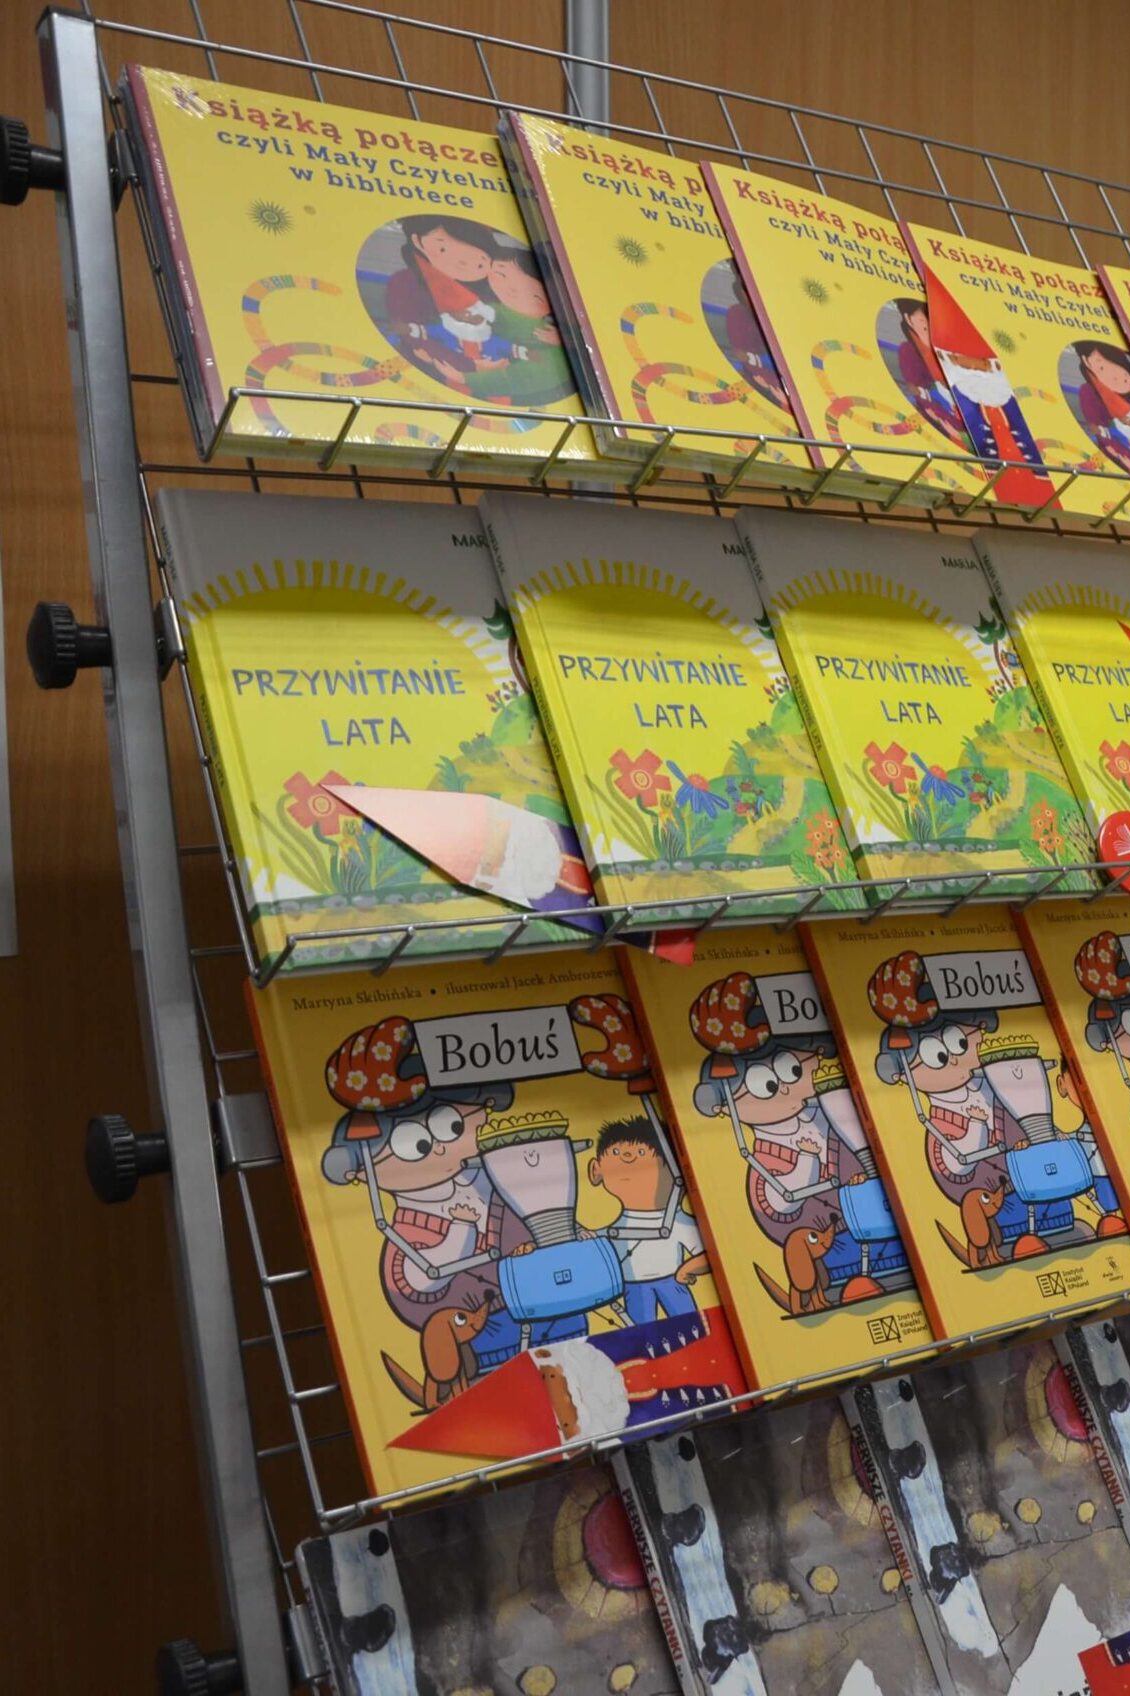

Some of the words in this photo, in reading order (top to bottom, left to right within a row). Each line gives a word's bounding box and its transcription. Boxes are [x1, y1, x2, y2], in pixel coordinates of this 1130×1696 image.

[217, 131, 294, 155] czyli
[304, 142, 377, 173] Mały
[289, 166, 313, 181] w
[325, 168, 474, 209] bibliotece
[583, 172, 642, 197] czyli
[648, 187, 705, 217] Mały
[733, 178, 847, 232] Książką
[640, 207, 658, 221] w
[667, 211, 723, 239] bibli
[768, 217, 819, 241] czyli
[824, 230, 872, 260] Mały
[819, 250, 834, 263] w
[928, 238, 1024, 282] Książką
[959, 273, 1004, 293] czyli
[1007, 283, 1049, 306] Mały
[1005, 301, 1018, 314] w
[1024, 303, 1111, 336] bibliotece
[321, 717, 411, 747] LATA
[633, 702, 708, 729] LATA
[880, 700, 942, 725] LATA
[293, 995, 353, 1011] Martyna
[356, 987, 421, 1004] Skibińska
[513, 974, 545, 991] Jacek
[939, 960, 1025, 999] Bobuś
[773, 989, 818, 1024] Bo
[435, 1018, 559, 1074] Bobuś
[1063, 1363, 1098, 1434] PIERWSZE
[1092, 1434, 1125, 1505] CZYTANKI
[851, 1424, 886, 1511] PIERWSZE
[879, 1505, 914, 1582] CZYTANKI
[621, 1488, 656, 1577] PIERWSZE
[650, 1576, 684, 1661] CZYTANKI
